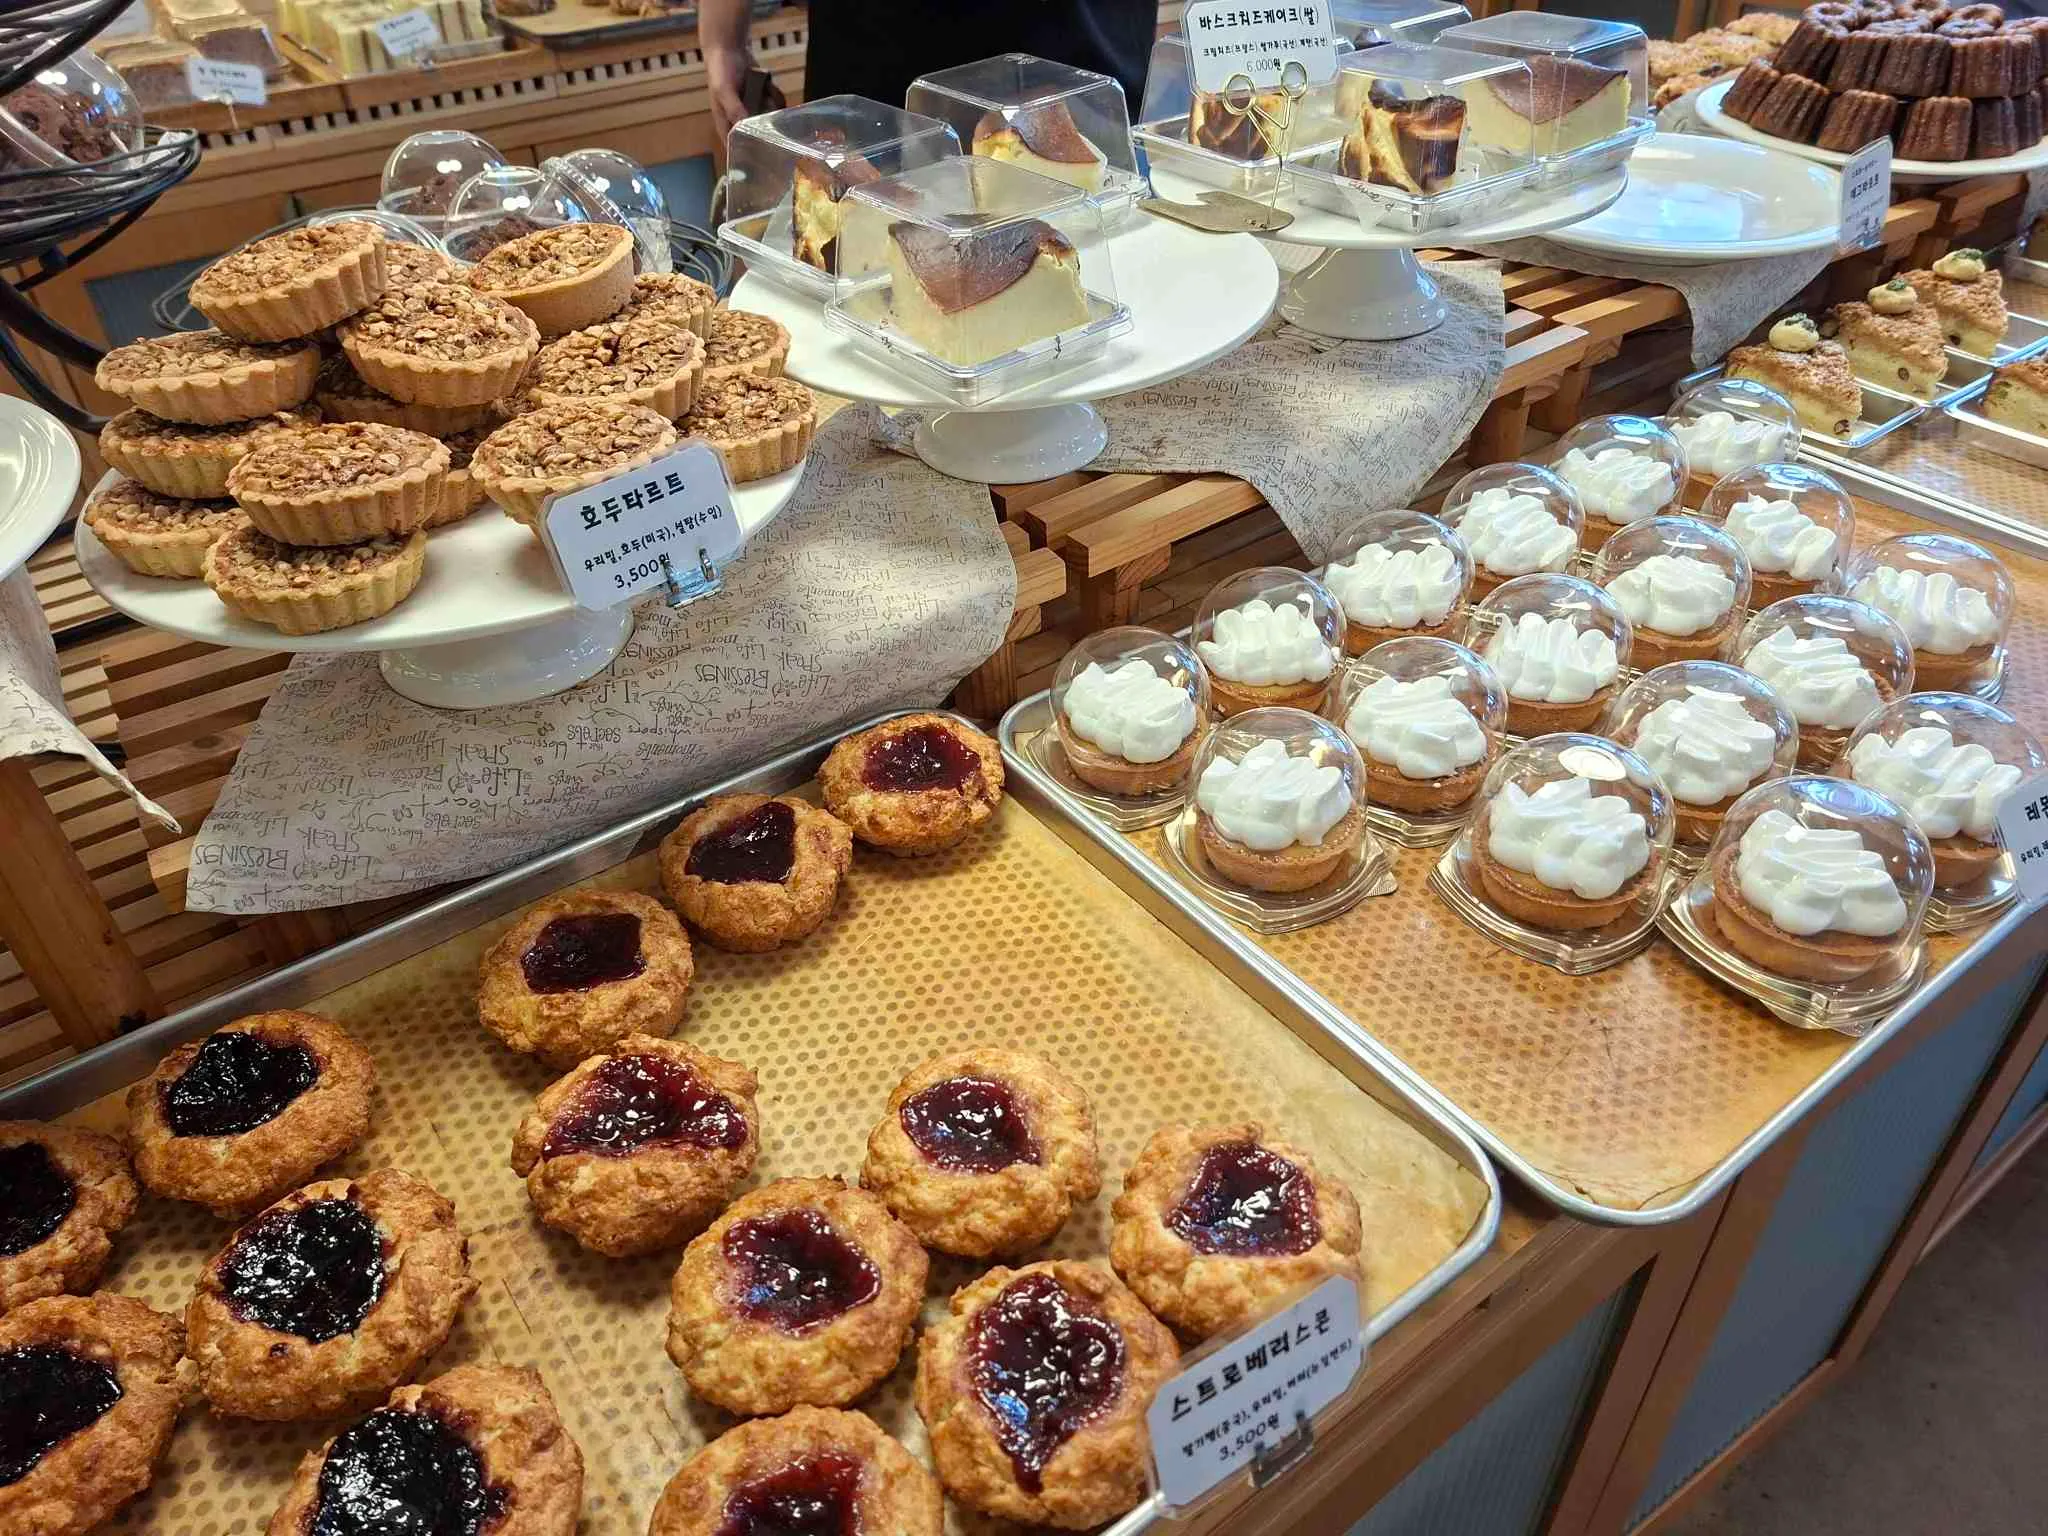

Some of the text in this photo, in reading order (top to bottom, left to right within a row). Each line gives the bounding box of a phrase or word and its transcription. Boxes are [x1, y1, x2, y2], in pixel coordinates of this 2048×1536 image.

[1199, 6, 1319, 30] 바스크치즈케이크(쌀)
[580, 472, 685, 530] 호두타르트
[1171, 1308, 1330, 1421] 스트로베리스콘
